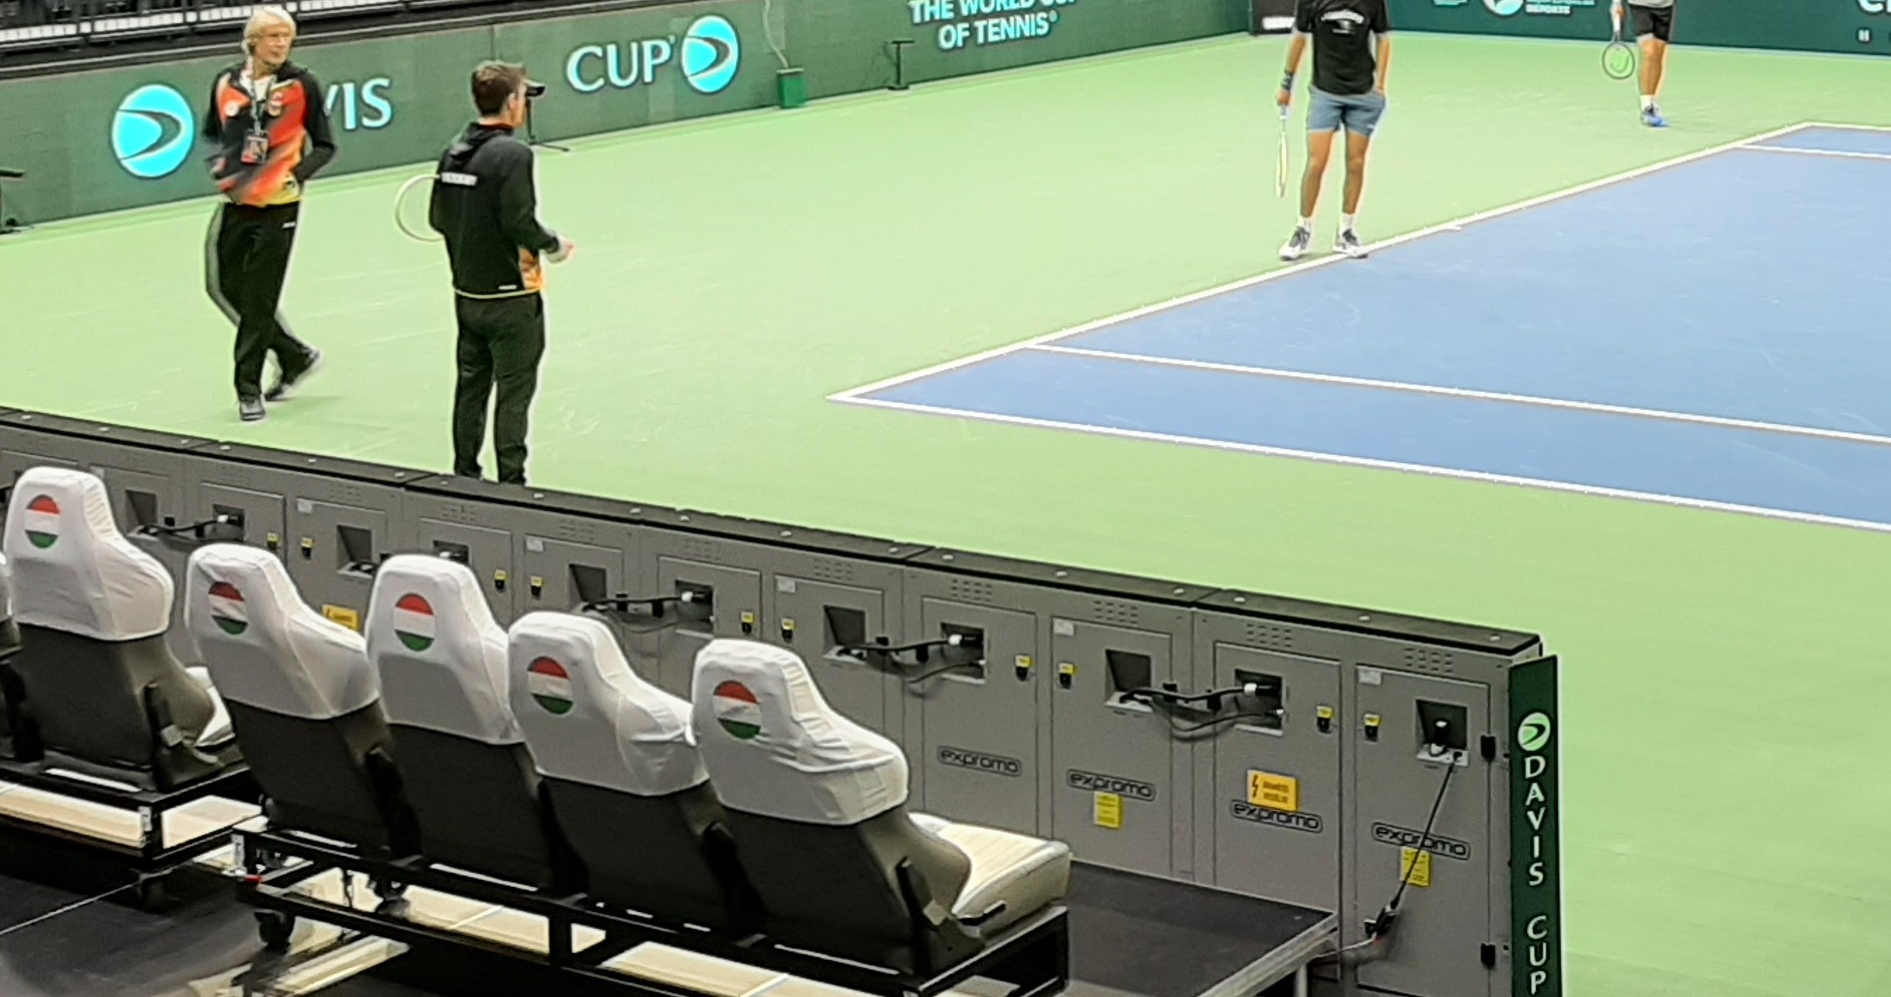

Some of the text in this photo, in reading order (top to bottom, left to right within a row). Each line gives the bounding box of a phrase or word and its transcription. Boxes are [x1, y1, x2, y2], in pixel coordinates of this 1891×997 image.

[938, 22, 970, 50] OF
[940, 749, 1018, 774] expromo
[1069, 771, 1152, 798] expromo
[1233, 803, 1319, 830] expromo
[1525, 755, 1548, 995] DAVIS CUP
